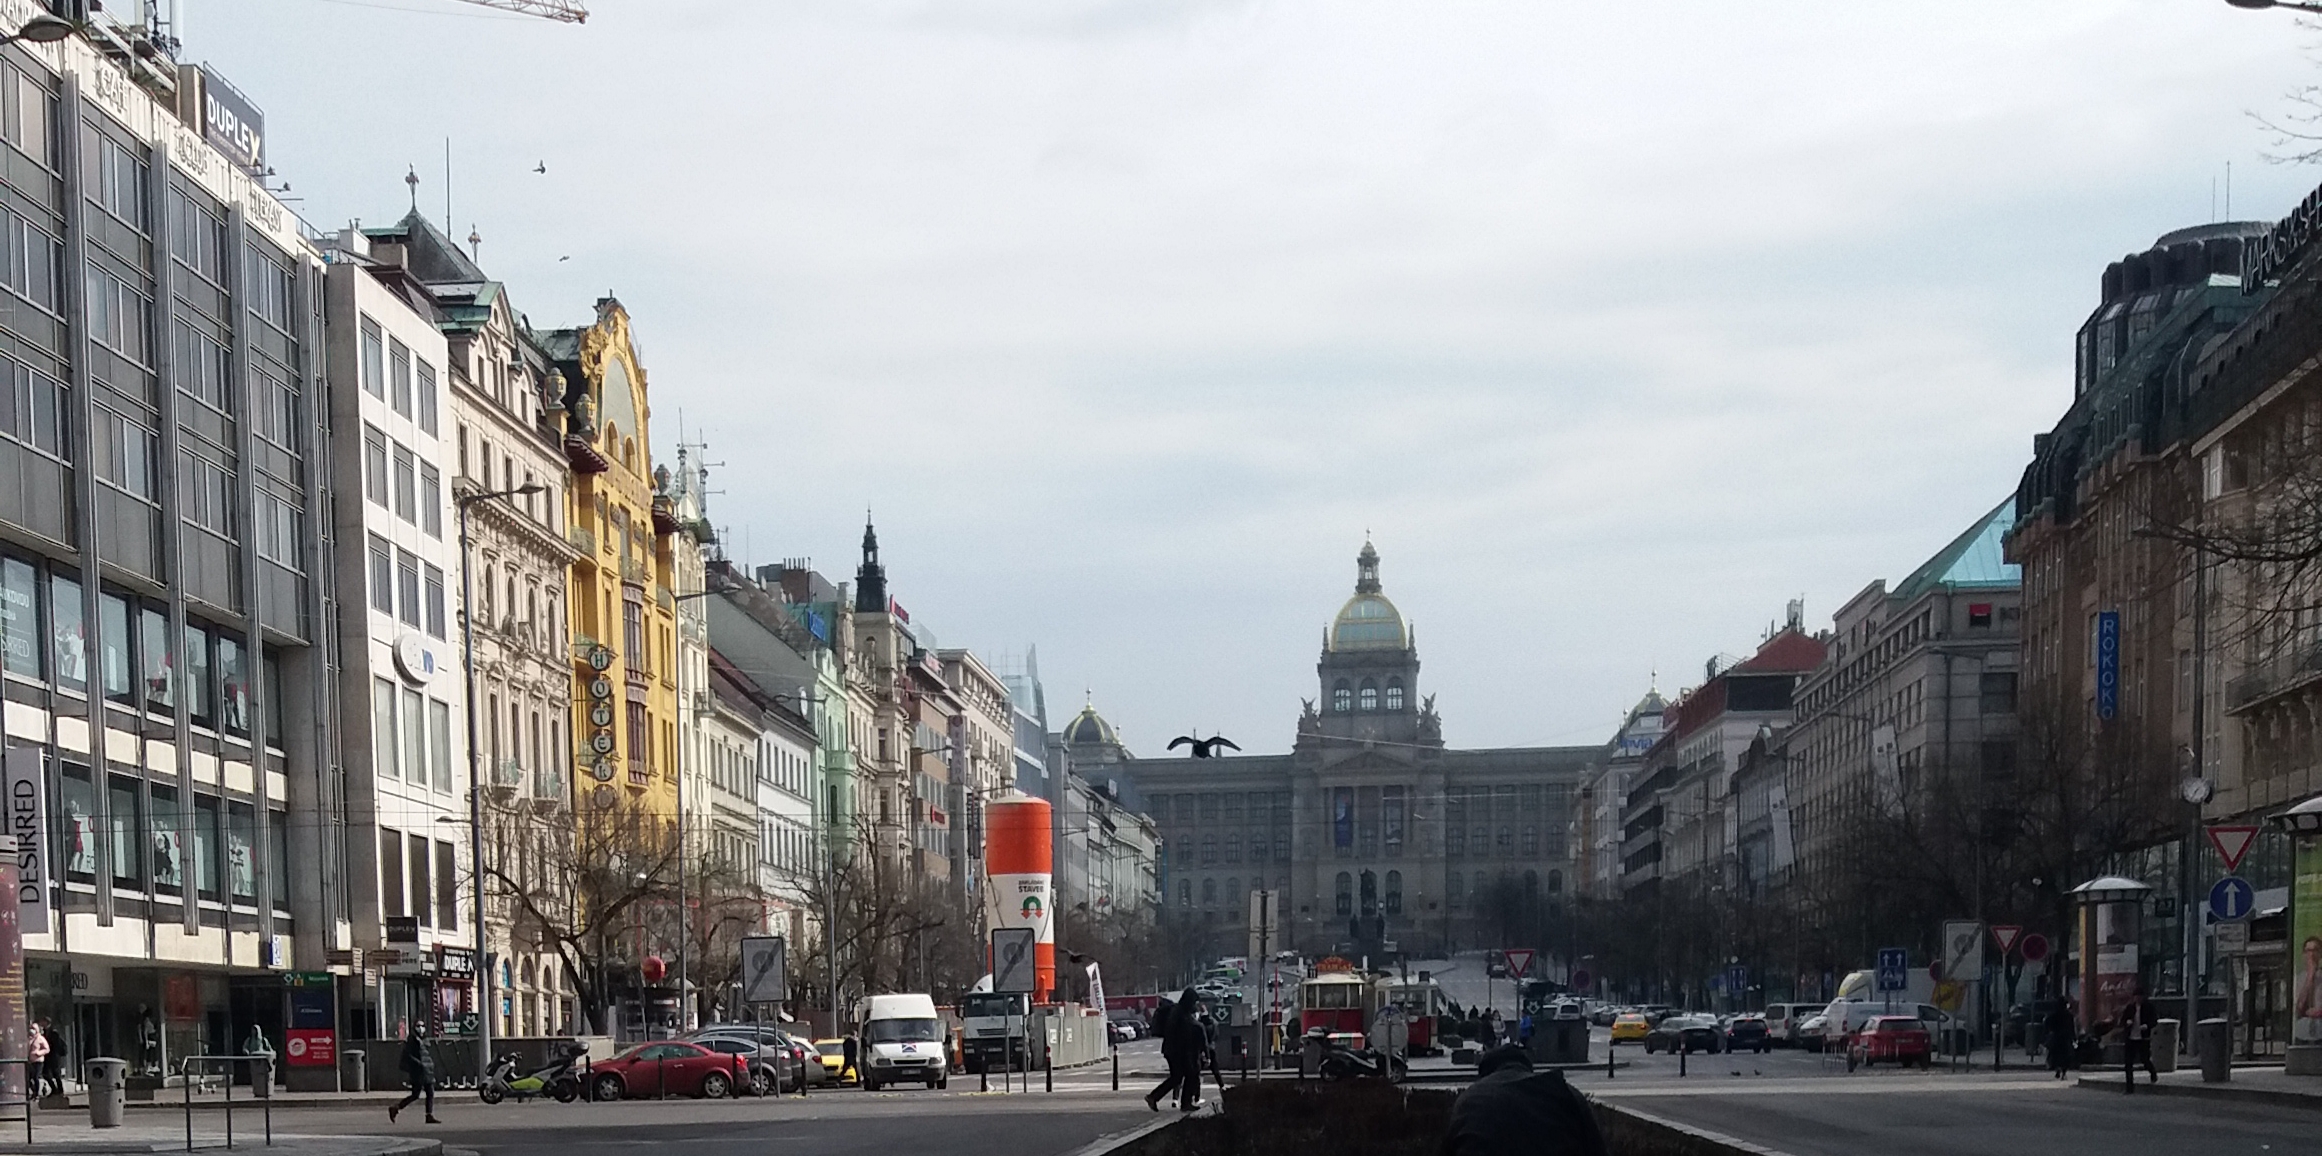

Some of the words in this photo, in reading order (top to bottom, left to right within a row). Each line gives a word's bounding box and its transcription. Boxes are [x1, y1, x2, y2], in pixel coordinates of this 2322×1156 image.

[206, 92, 260, 168] DUPLEX
[2102, 619, 2115, 719] ROKOKO
[14, 779, 40, 903] DESIRRED
